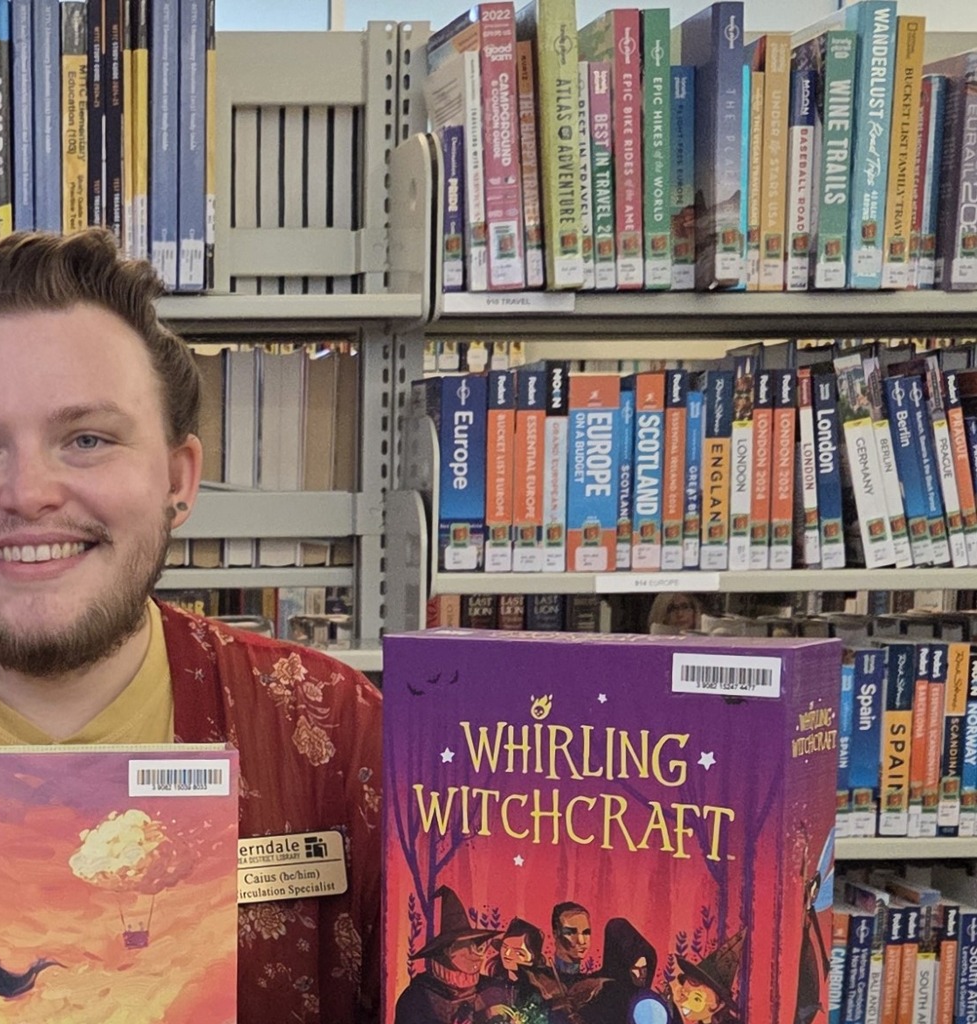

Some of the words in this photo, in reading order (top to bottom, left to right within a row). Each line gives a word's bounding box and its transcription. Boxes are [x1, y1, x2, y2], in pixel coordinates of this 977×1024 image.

[482, 9, 511, 21] 2022
[868, 7, 892, 120] WANDERLUST
[555, 78, 572, 121] ATLAS
[622, 72, 632, 102] EPIC
[652, 76, 663, 106] EPIC
[800, 79, 811, 117] MOON
[828, 78, 852, 132] WINE
[903, 66, 914, 120] BUCKET
[498, 72, 512, 167] CAMPGROUND
[594, 112, 610, 148] BEST
[623, 106, 633, 134] BIKE
[652, 110, 664, 148] HIKES
[900, 121, 911, 152] LIST
[595, 151, 610, 170] IN
[624, 138, 634, 176] RIDES
[799, 128, 810, 190] BASEBALL
[824, 138, 851, 206] TRAILS
[897, 153, 909, 199] FAMILY
[557, 144, 575, 225] ADVENTURE
[595, 172, 612, 222] TRAVEL
[653, 176, 664, 222] WORLD
[796, 194, 806, 232] ROAD
[501, 296, 532, 306] TRAVEL
[575, 413, 586, 429] ON
[575, 430, 586, 440] A
[756, 412, 766, 468] LONDON
[816, 408, 837, 474] London
[895, 410, 912, 448] Berlin
[449, 410, 474, 490] Europe
[526, 415, 538, 472] ESSENTIAL
[574, 441, 585, 484] BUDGET
[584, 412, 613, 498] EUROPE
[636, 414, 661, 516] SCOTLAND
[880, 438, 893, 473] BERLIN
[938, 438, 954, 480] PRAGUE
[710, 442, 724, 522] ENGLAN
[736, 438, 747, 493] LONDON
[756, 470, 766, 500] 2024
[804, 442, 815, 491] LONDON
[855, 438, 874, 497] GERMANY
[525, 474, 536, 520] EUROPE
[648, 579, 680, 587] EUROPE
[856, 683, 877, 731] Spain
[458, 718, 691, 788] WHIRLING
[838, 736, 850, 769] SPAIN
[412, 783, 736, 863] WITCHCRAFT
[239, 838, 300, 856] erndale
[276, 852, 300, 862] LIBRARY
[237, 886, 286, 900] irculation
[288, 882, 336, 896] Specialist
[244, 872, 277, 885] Caius
[279, 868, 321, 882] (he/him)
